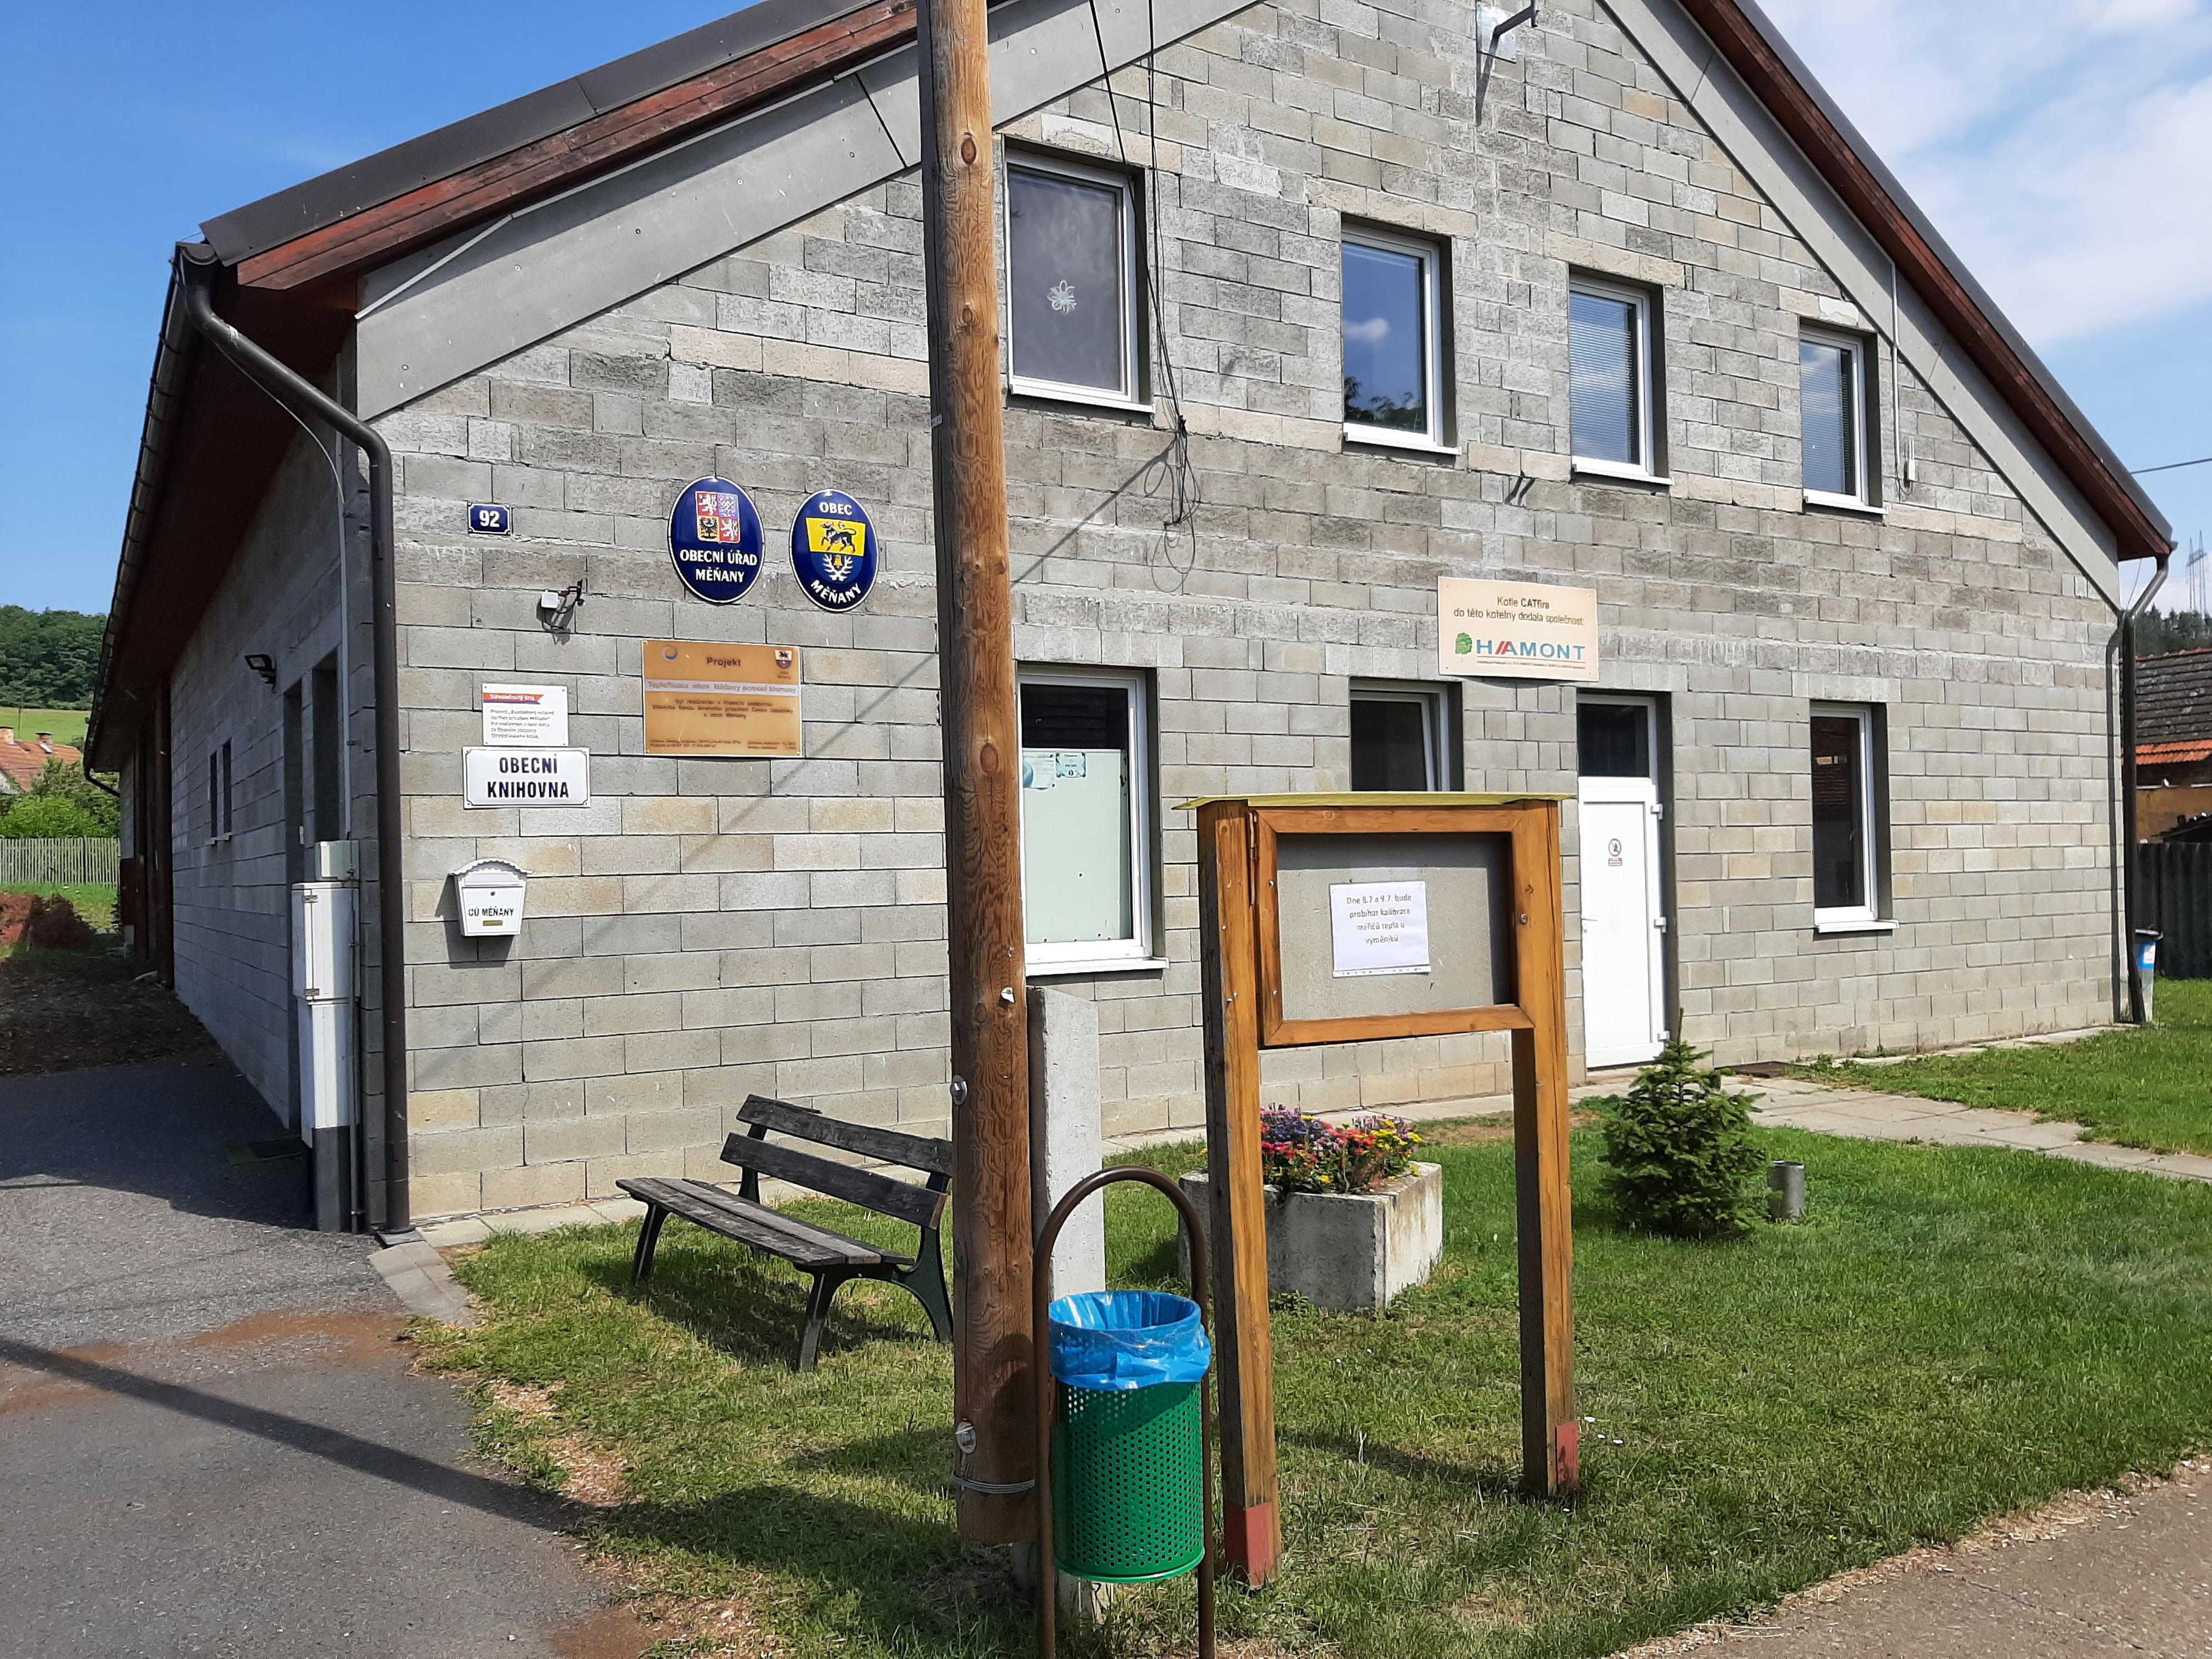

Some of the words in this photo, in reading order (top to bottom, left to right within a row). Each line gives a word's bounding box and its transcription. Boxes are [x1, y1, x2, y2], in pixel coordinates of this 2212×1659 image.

[819, 502, 852, 515] OBEC
[479, 510, 499, 527] 92
[680, 549, 724, 563] OBECNÍ
[727, 550, 758, 566] ÚŘAD
[696, 567, 745, 583] MĚŇANY
[811, 580, 862, 603] MĚŇANY
[1498, 597, 1518, 607] Kotle
[1521, 598, 1550, 609] CATfire
[1454, 608, 1465, 618] do
[1467, 609, 1484, 618] této
[1486, 610, 1516, 622] kotelny
[1519, 612, 1543, 622] dodala
[1477, 639, 1585, 660] HAMONT
[707, 656, 741, 668] Projekt
[499, 754, 557, 774] OBECNÍ
[487, 781, 570, 798] KNIHOVNA
[482, 906, 514, 916] MĚŇANY
